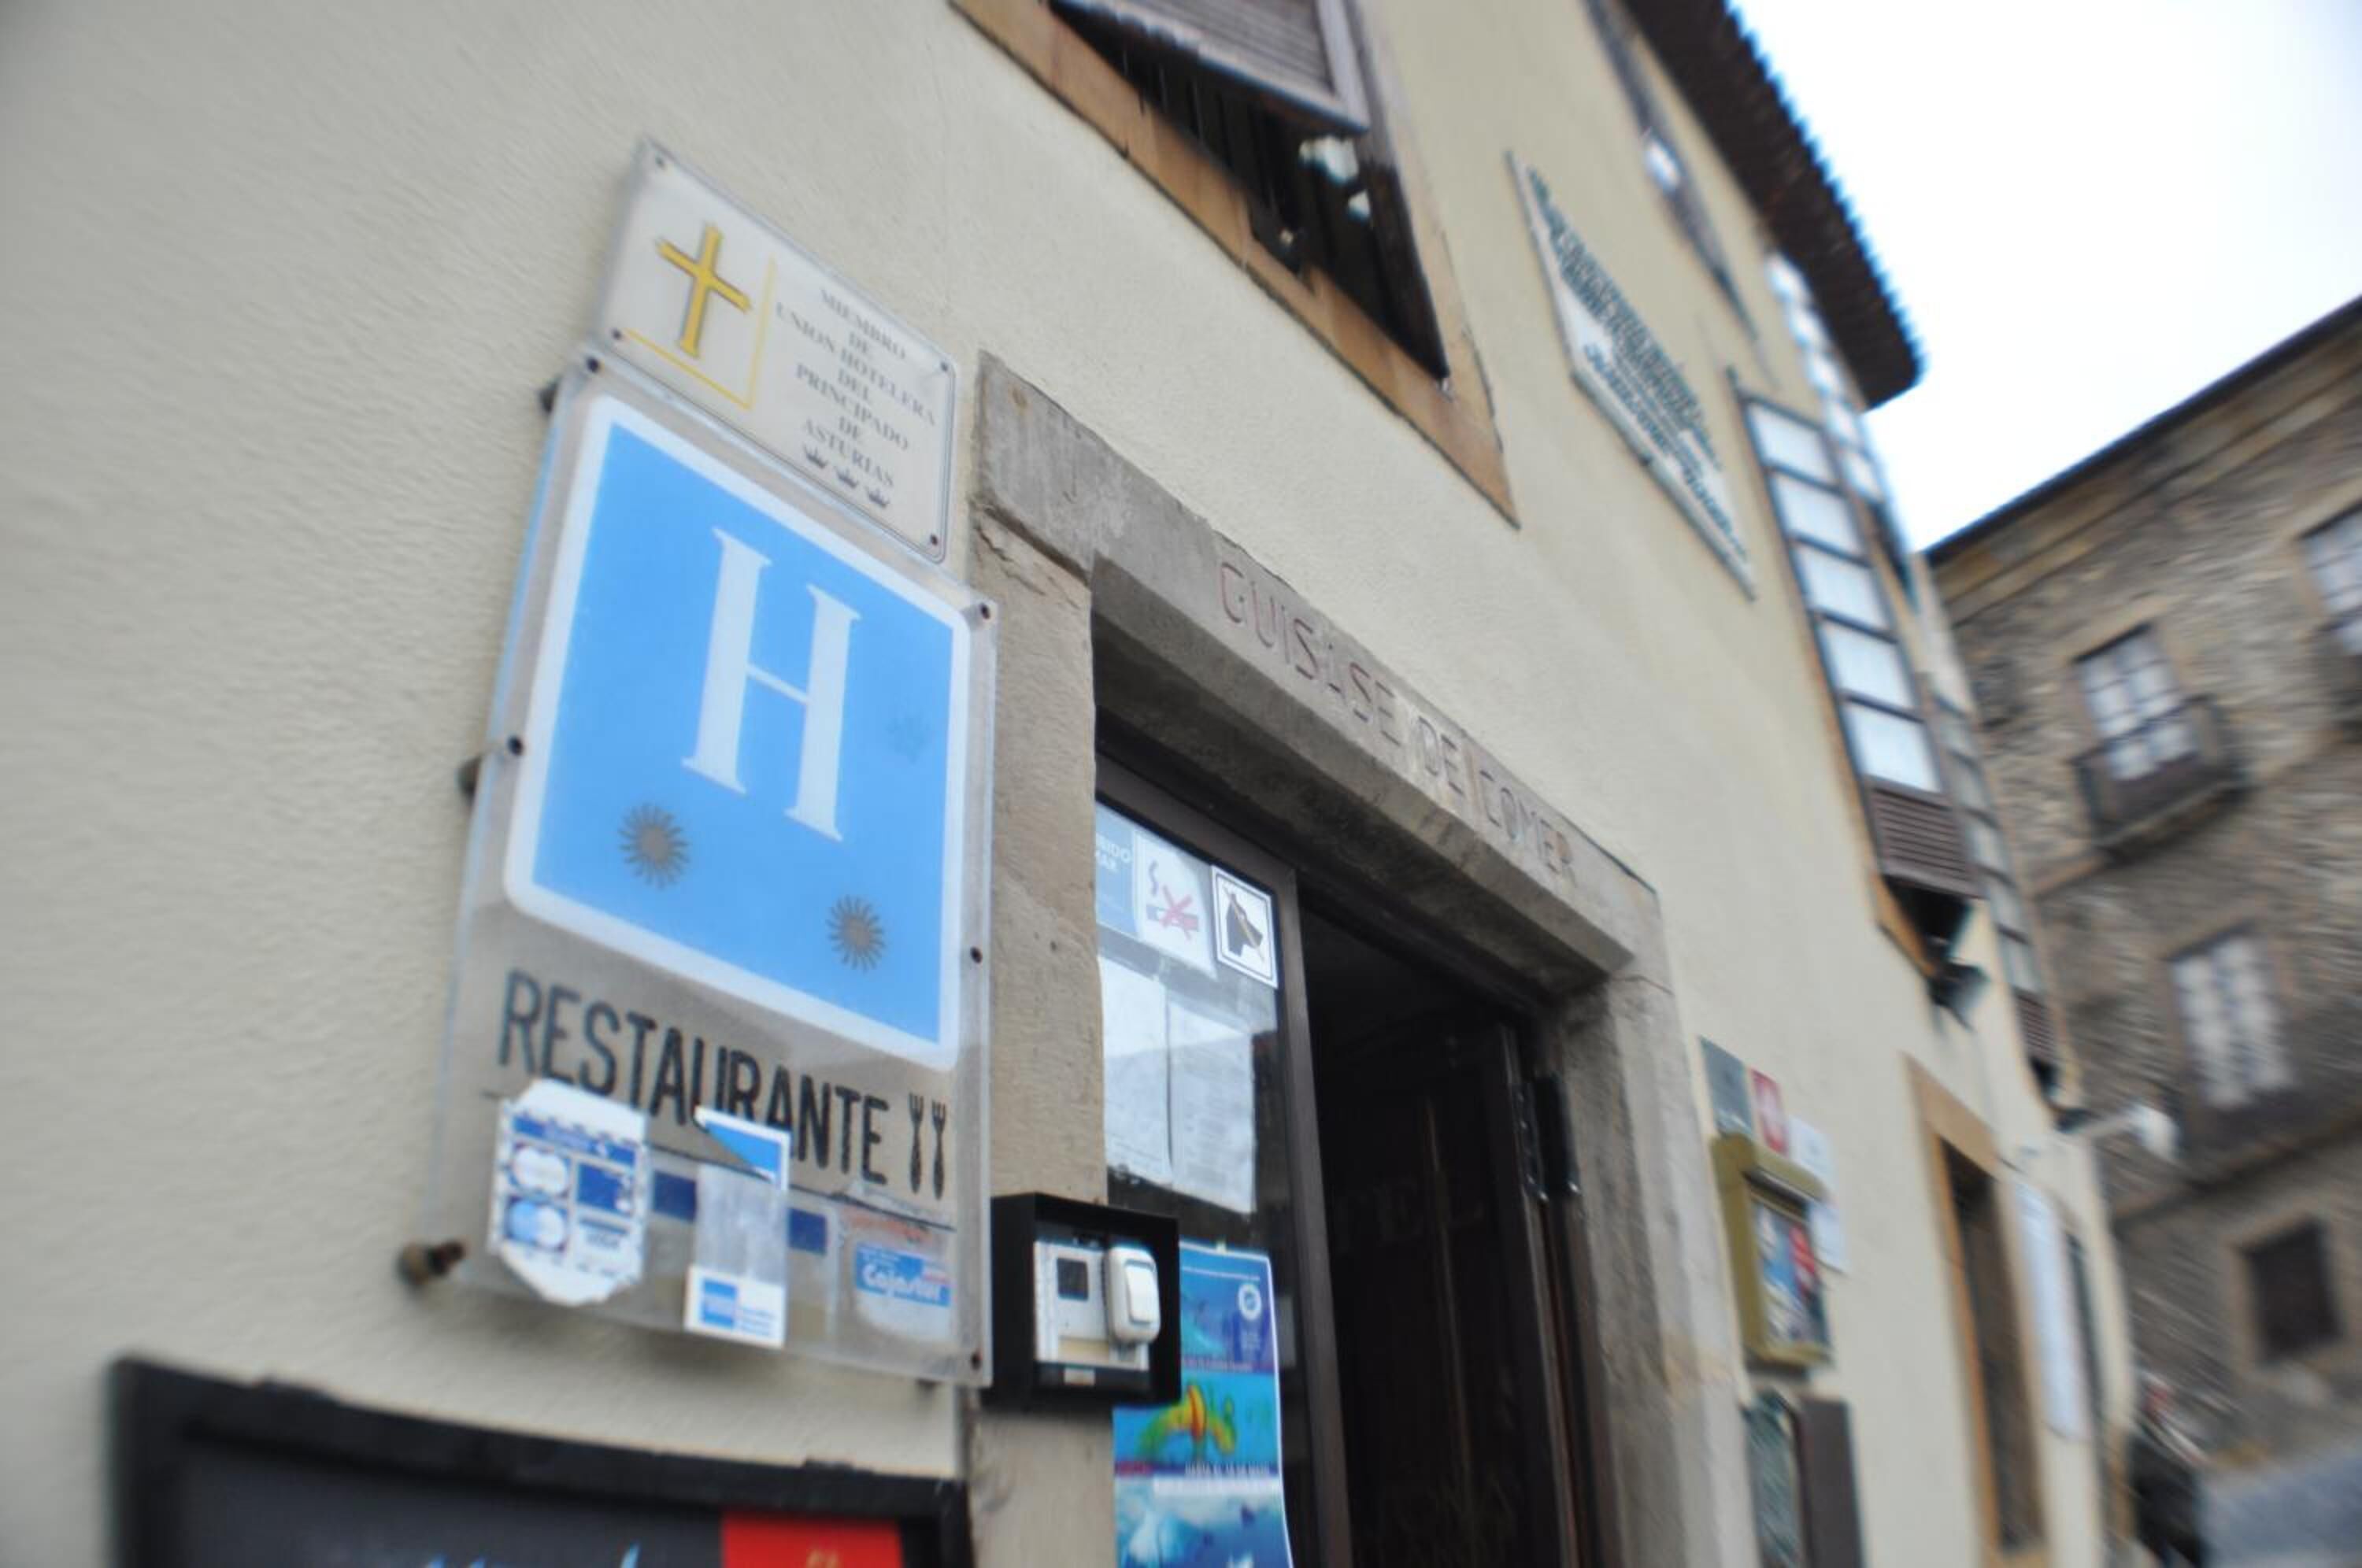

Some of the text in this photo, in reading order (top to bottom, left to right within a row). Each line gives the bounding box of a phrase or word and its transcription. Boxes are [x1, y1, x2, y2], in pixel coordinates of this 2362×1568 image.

[775, 301, 936, 427] UNION HOTELERA
[820, 288, 906, 361] MIEMBRO
[848, 331, 871, 356] DE
[795, 363, 909, 452] PRINCIPADO
[838, 368, 872, 404] DEL
[802, 418, 894, 488] ASTURIAS
[838, 415, 864, 442] DE
[681, 527, 862, 842] H
[1415, 714, 1468, 801] DE
[498, 970, 890, 1186] RESTAURANTE
